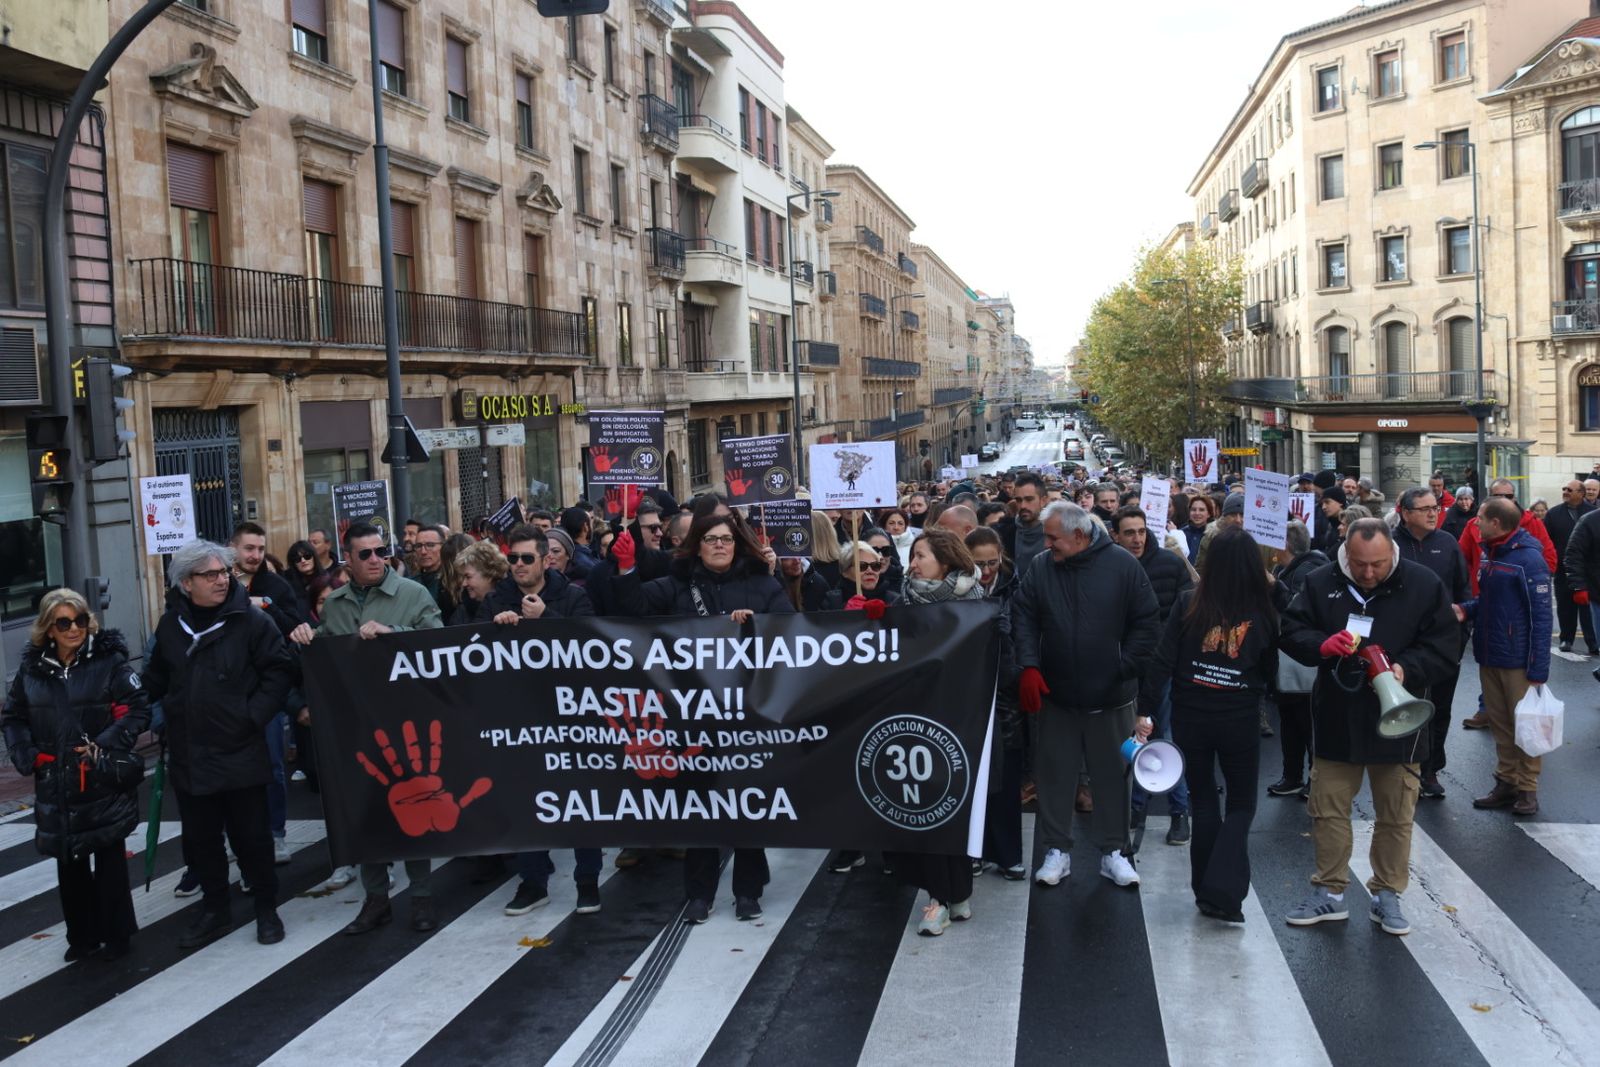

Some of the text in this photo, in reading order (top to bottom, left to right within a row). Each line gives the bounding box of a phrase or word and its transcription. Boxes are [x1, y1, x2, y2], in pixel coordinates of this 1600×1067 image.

[1378, 418, 1408, 428] OPORTO
[640, 454, 652, 464] 30
[771, 474, 783, 484] 30
[156, 532, 176, 542] España
[792, 533, 803, 541] 30
[389, 628, 900, 682] AUTÓNOMOS ASFIXIADOS!!
[1199, 663, 1219, 671] PULMÓN
[1194, 674, 1216, 683] NECESITA
[555, 686, 746, 721] BASTA YA!!
[636, 728, 681, 747] POR
[684, 730, 714, 748] LA
[717, 725, 828, 748] DIGNIDAD
[861, 721, 963, 772] MANIFESTACION NACIONAL
[545, 752, 572, 771] DE
[576, 753, 617, 770] LOS
[886, 744, 933, 781] 30
[902, 784, 920, 804] N
[535, 787, 798, 823] SALAMANCA
[872, 795, 957, 825] DE AUTONOMOS
